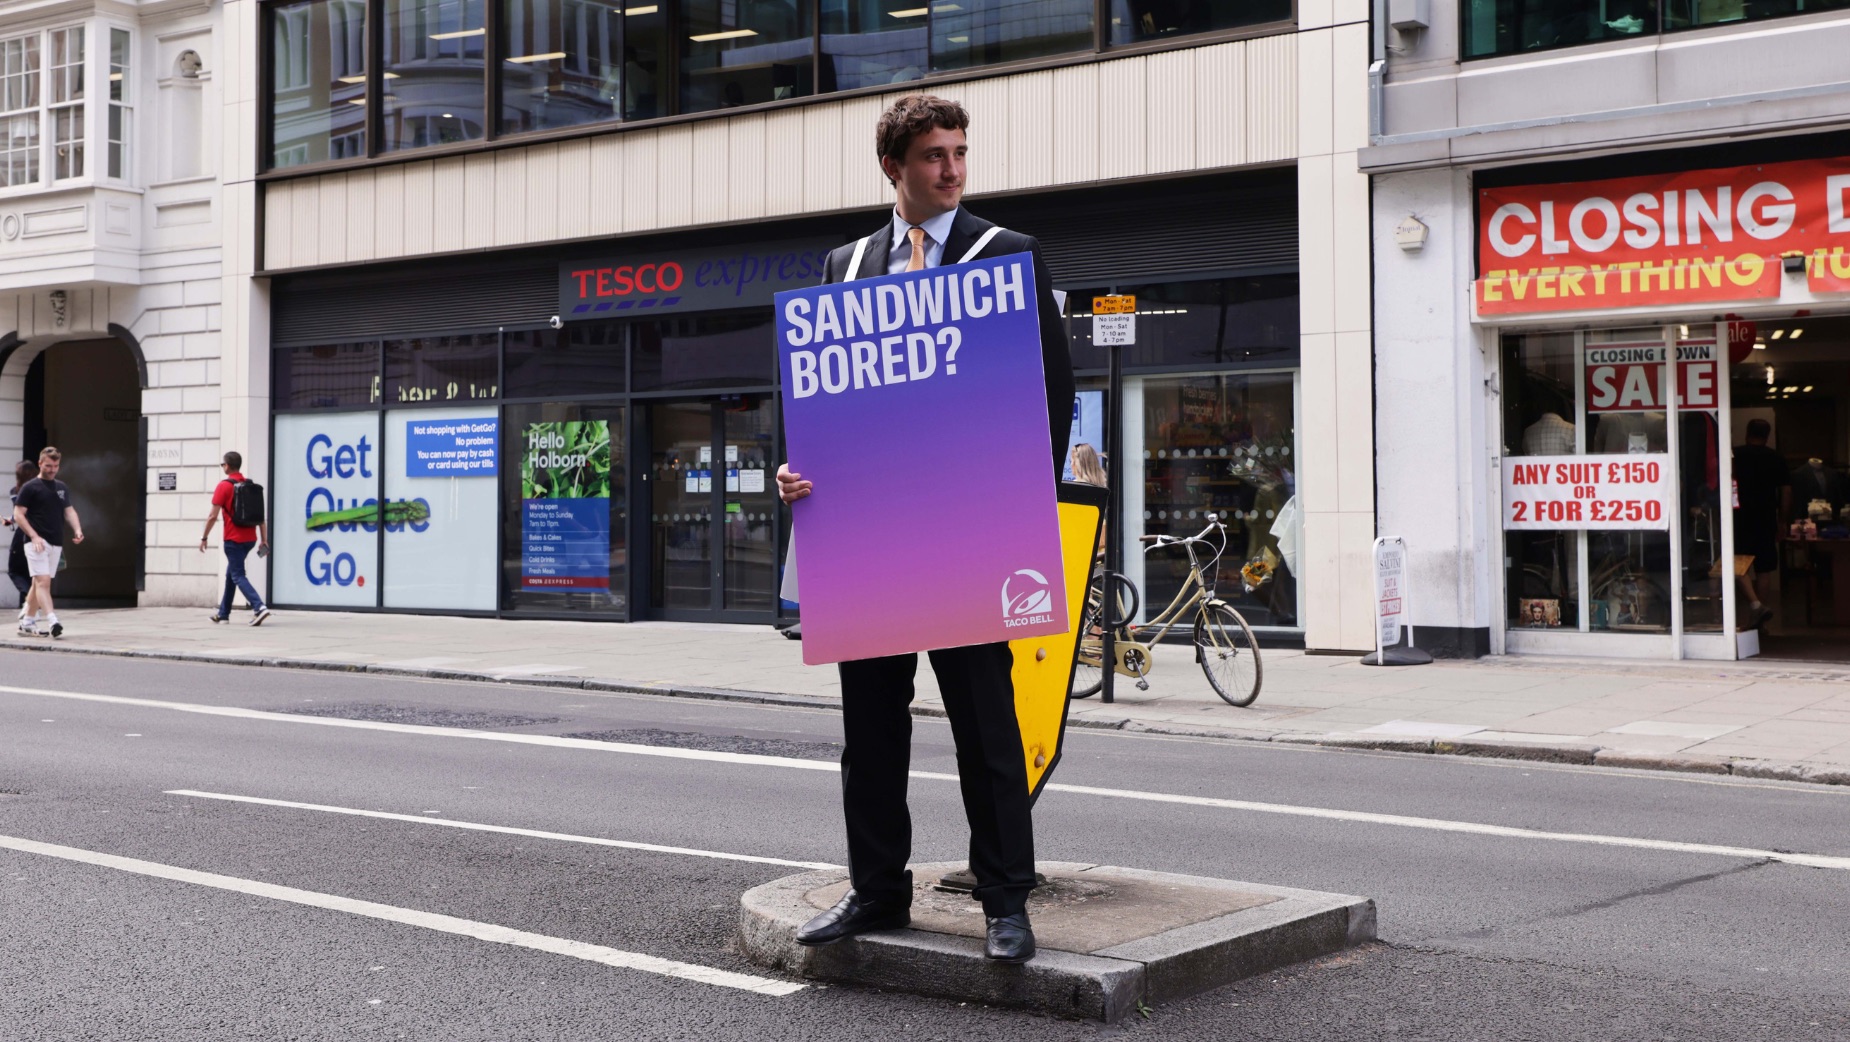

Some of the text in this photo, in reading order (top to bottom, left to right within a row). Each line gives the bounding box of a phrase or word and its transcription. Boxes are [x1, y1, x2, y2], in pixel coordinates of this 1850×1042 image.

[1488, 181, 1796, 258] CLOSING
[571, 261, 684, 298] TESCO
[1483, 252, 1765, 302] EVERYTHING
[785, 262, 1026, 347] SANDWICH
[1728, 322, 1748, 343] ale
[790, 326, 962, 400] BORED?
[1590, 348, 1654, 363] CLOSING
[1592, 362, 1713, 408] SALE
[414, 423, 496, 436] Not shopping with GetGo?
[529, 431, 565, 449] Hello
[456, 437, 465, 446] No
[306, 434, 372, 479] Get
[417, 451, 429, 459] You
[457, 451, 468, 460] pay
[470, 449, 478, 459] by
[478, 448, 494, 457] cash
[529, 451, 590, 469] Holborn.
[436, 460, 450, 469] card
[452, 460, 468, 470] using
[1513, 462, 1659, 485] ANY SUIT £150
[1574, 486, 1596, 499] OR
[1512, 500, 1661, 522] 2 FOR £250
[305, 540, 365, 587] Go.
[1003, 614, 1052, 628] TACO BELL
